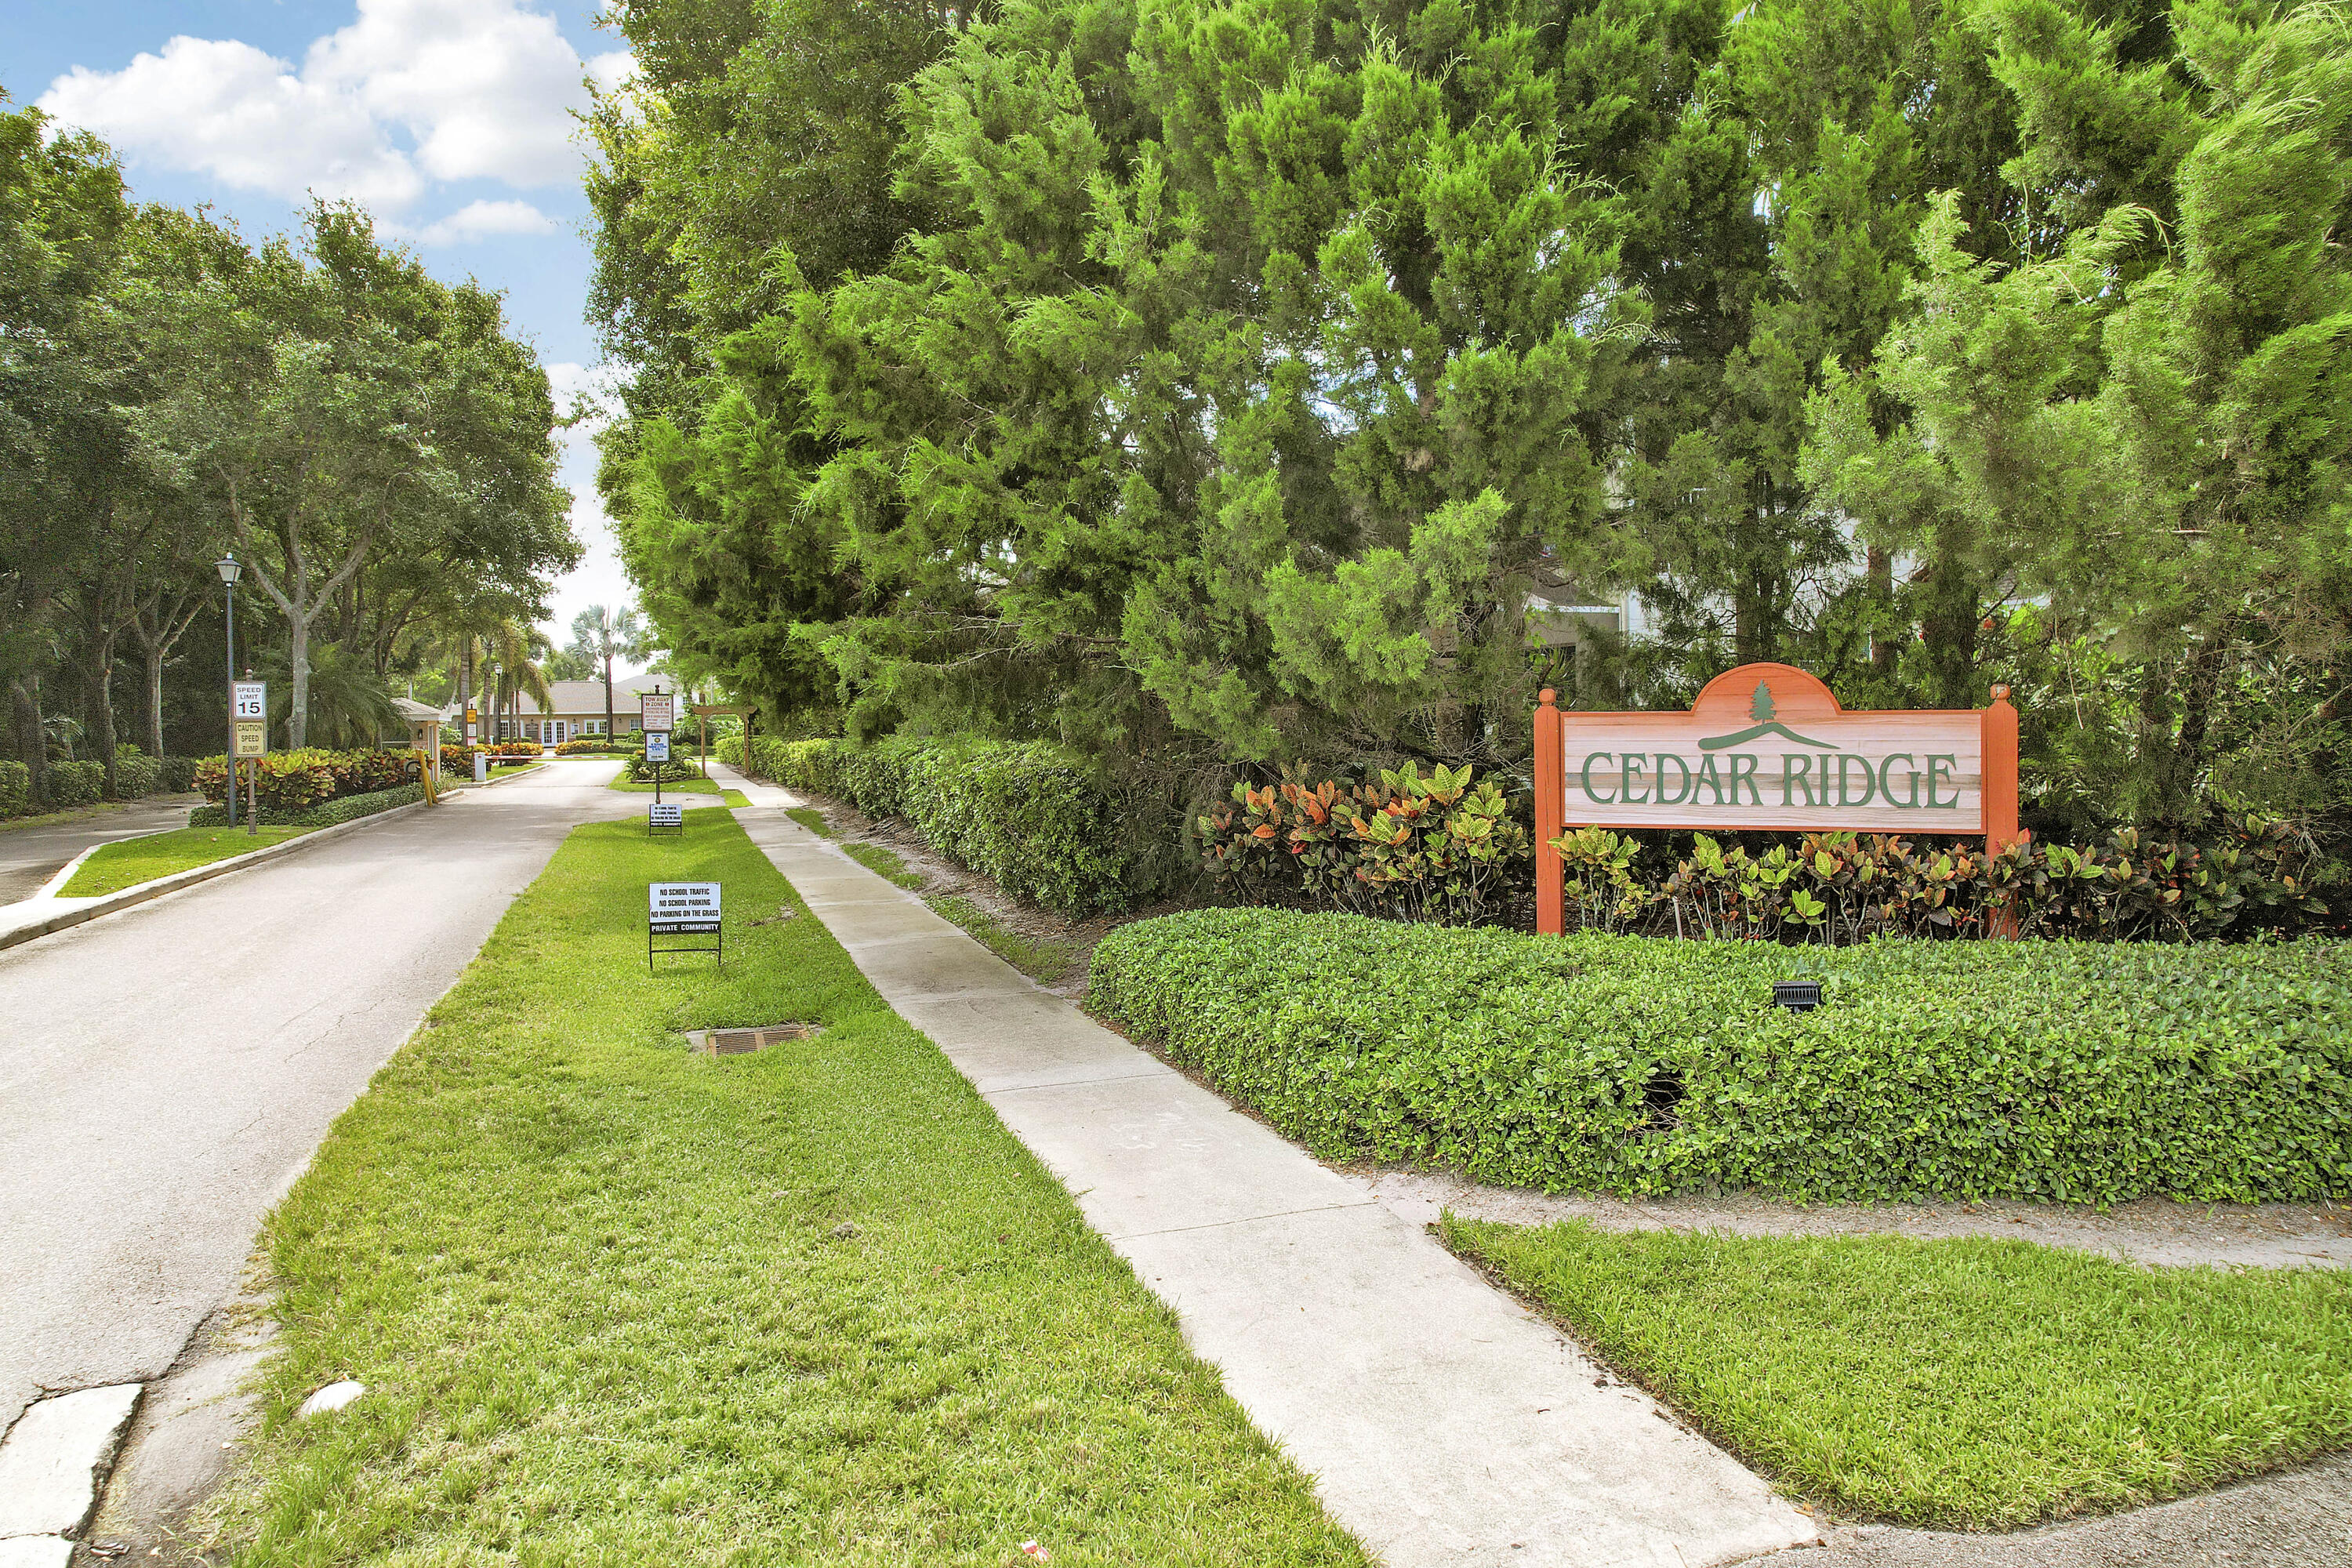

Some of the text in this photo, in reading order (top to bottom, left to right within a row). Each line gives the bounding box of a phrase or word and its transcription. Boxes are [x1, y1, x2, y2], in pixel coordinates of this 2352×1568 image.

[238, 702, 260, 714] 15
[1581, 751, 1961, 809] CEDAR RIDGE
